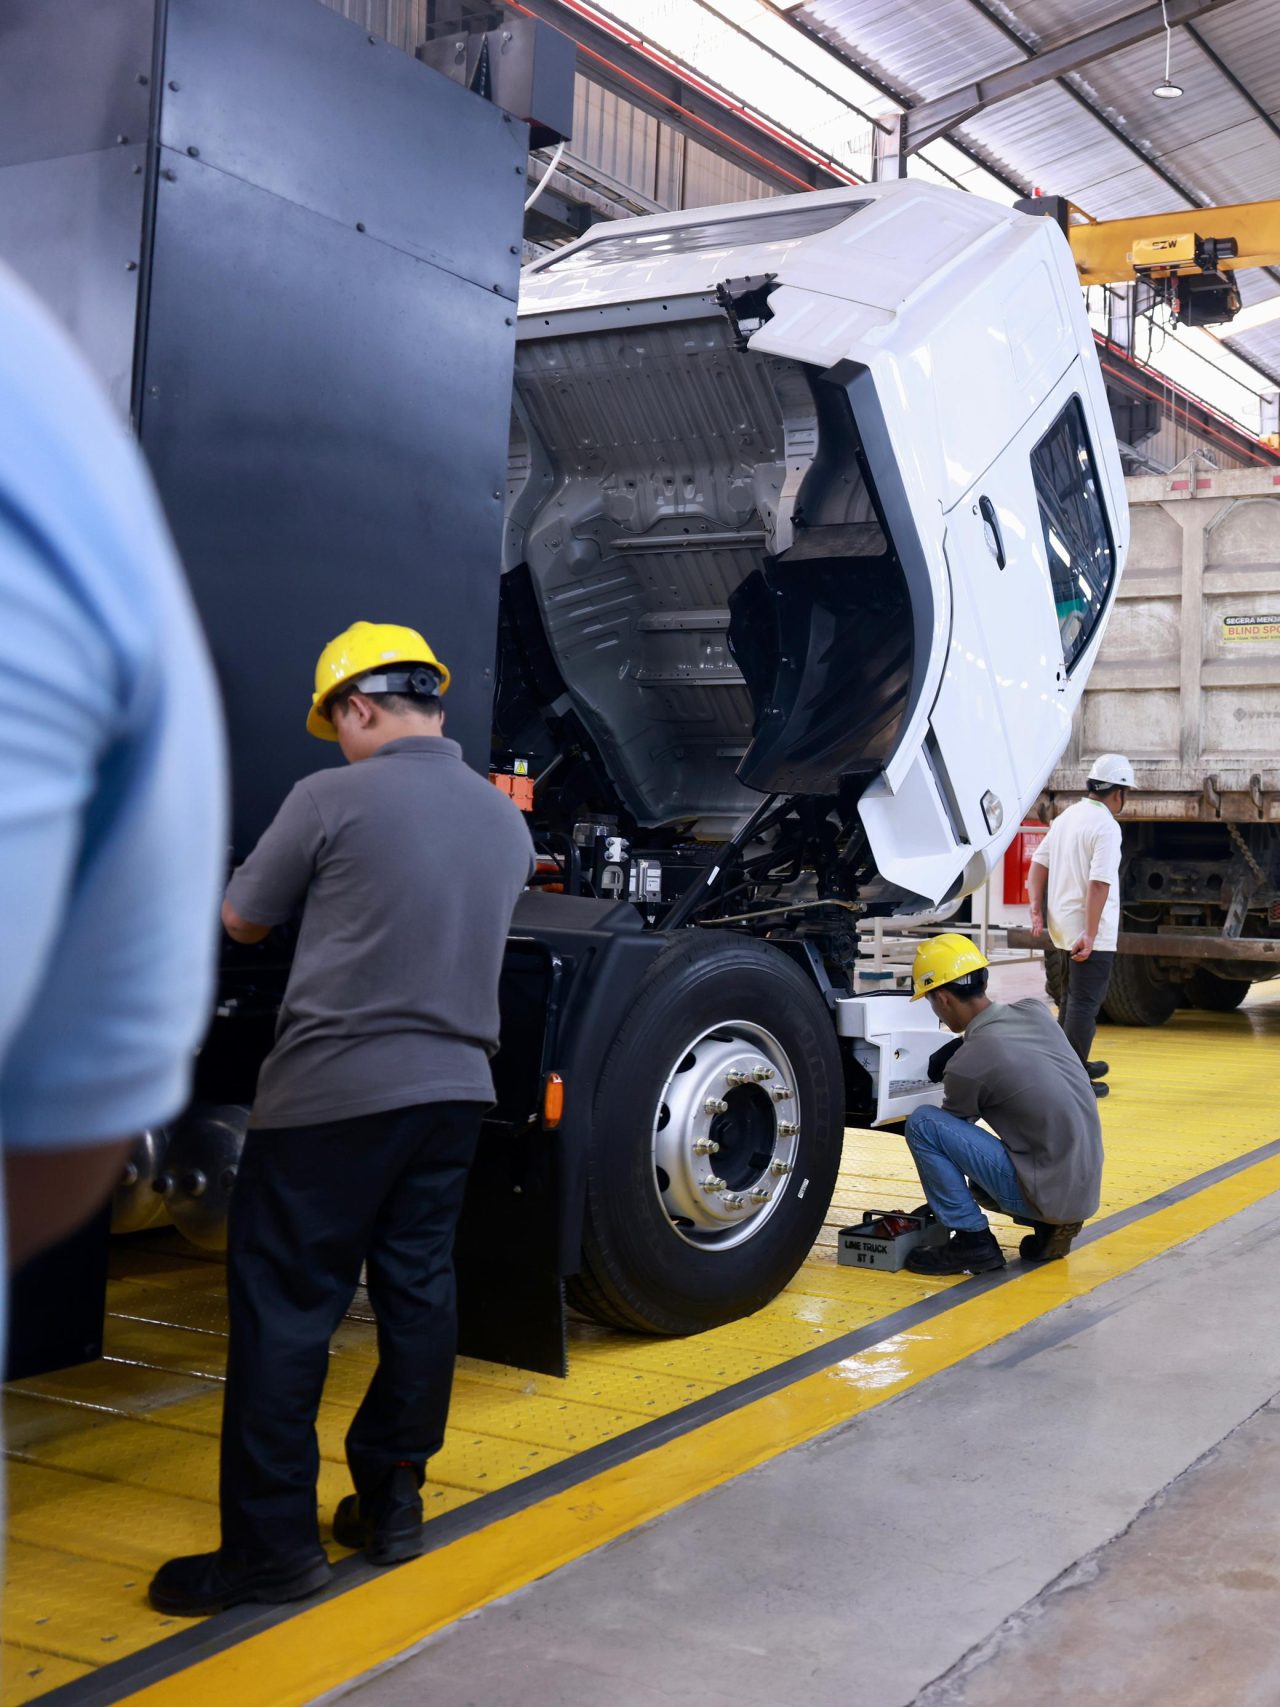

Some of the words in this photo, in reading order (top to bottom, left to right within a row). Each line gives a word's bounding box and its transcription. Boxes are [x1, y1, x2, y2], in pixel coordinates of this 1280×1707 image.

[1226, 617, 1255, 625] SEGERA
[1228, 626, 1260, 635] BLIND
[845, 1240, 861, 1250] LINE
[863, 1243, 888, 1254] TRUCK
